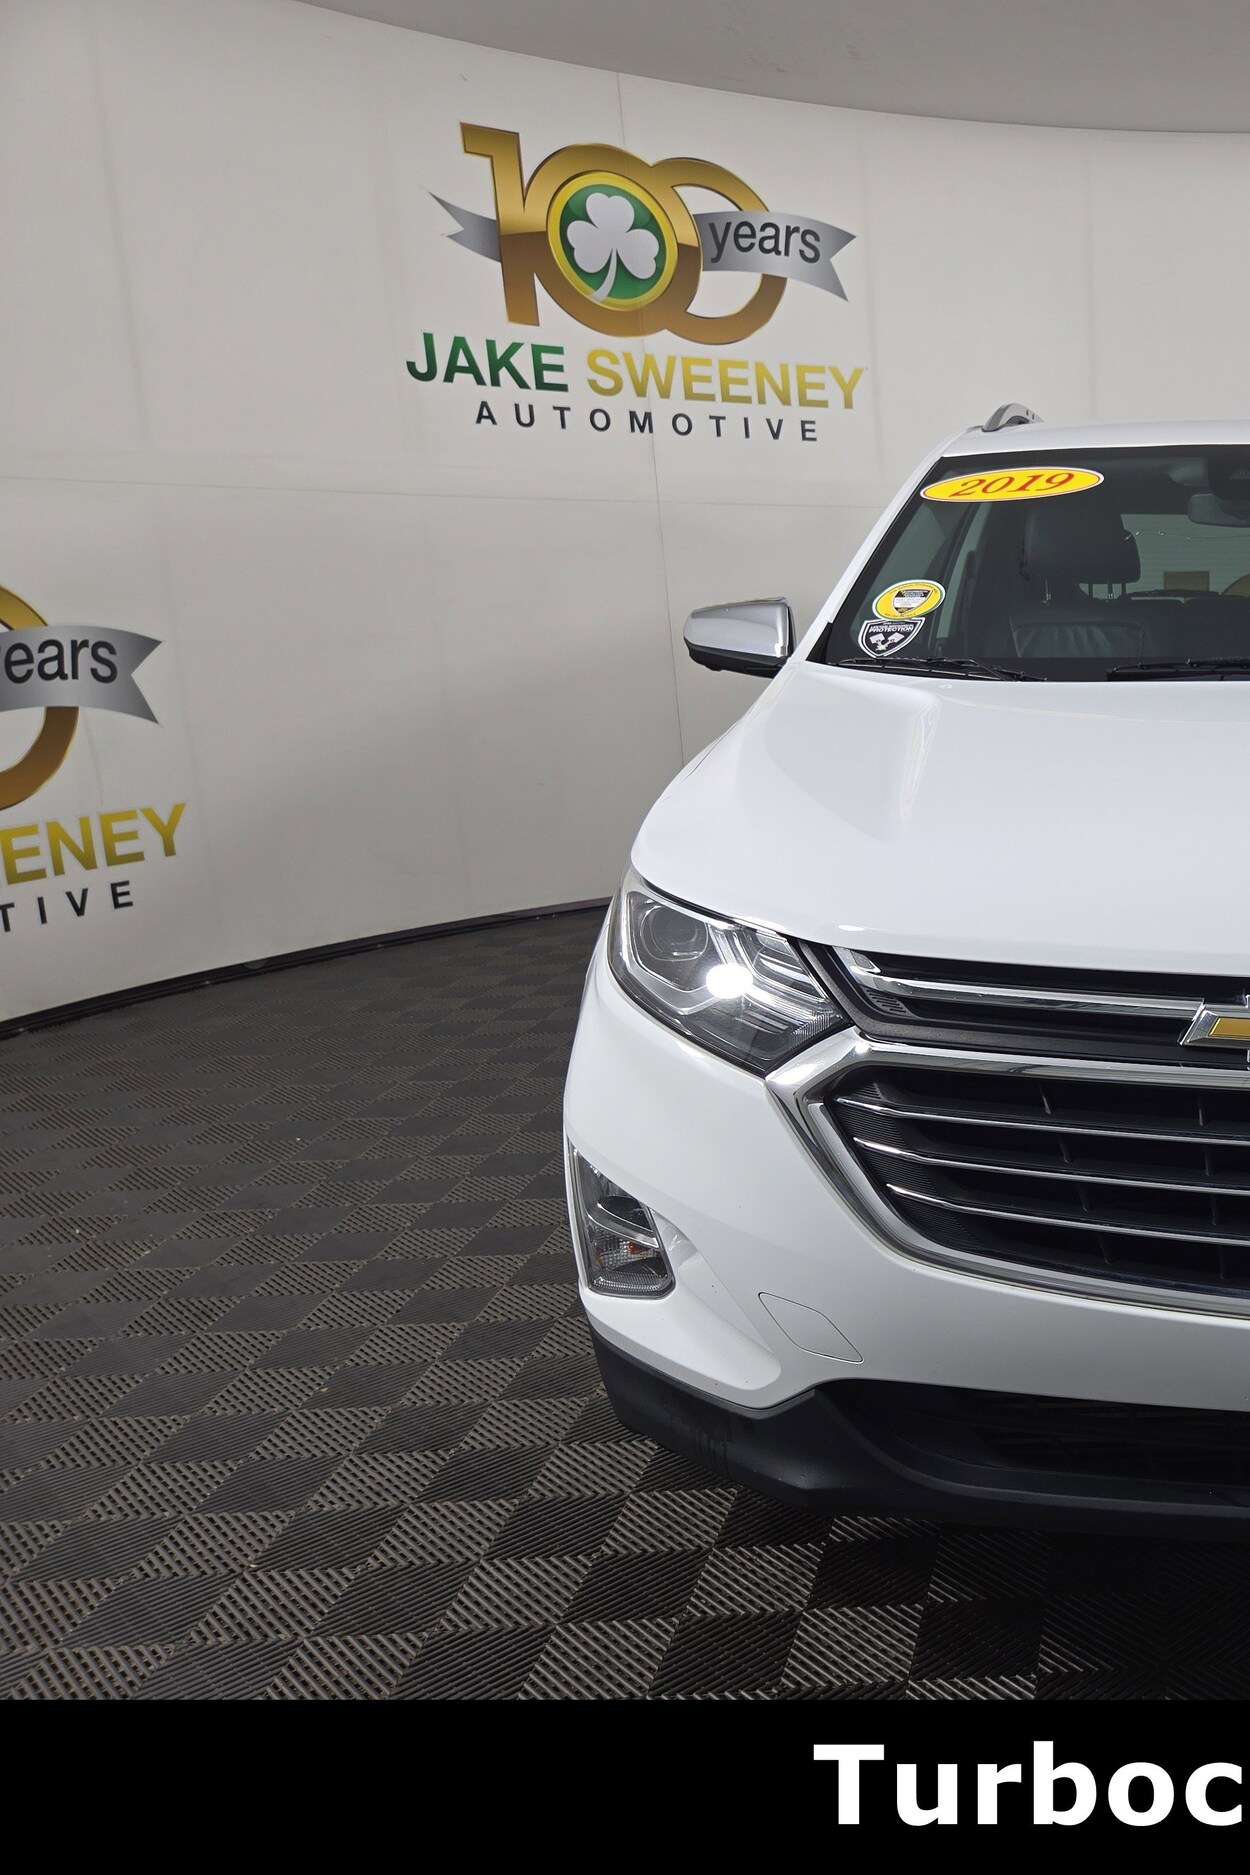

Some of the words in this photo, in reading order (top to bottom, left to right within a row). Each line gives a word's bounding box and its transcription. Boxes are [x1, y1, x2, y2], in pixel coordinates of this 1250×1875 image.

[459, 121, 788, 346] 100
[709, 219, 821, 264] years
[406, 332, 569, 392] JAKE
[587, 348, 866, 410] SWEENEY
[475, 400, 818, 442] AUTOMOTIVE
[949, 472, 1074, 497] 2019
[0, 638, 118, 684] ears
